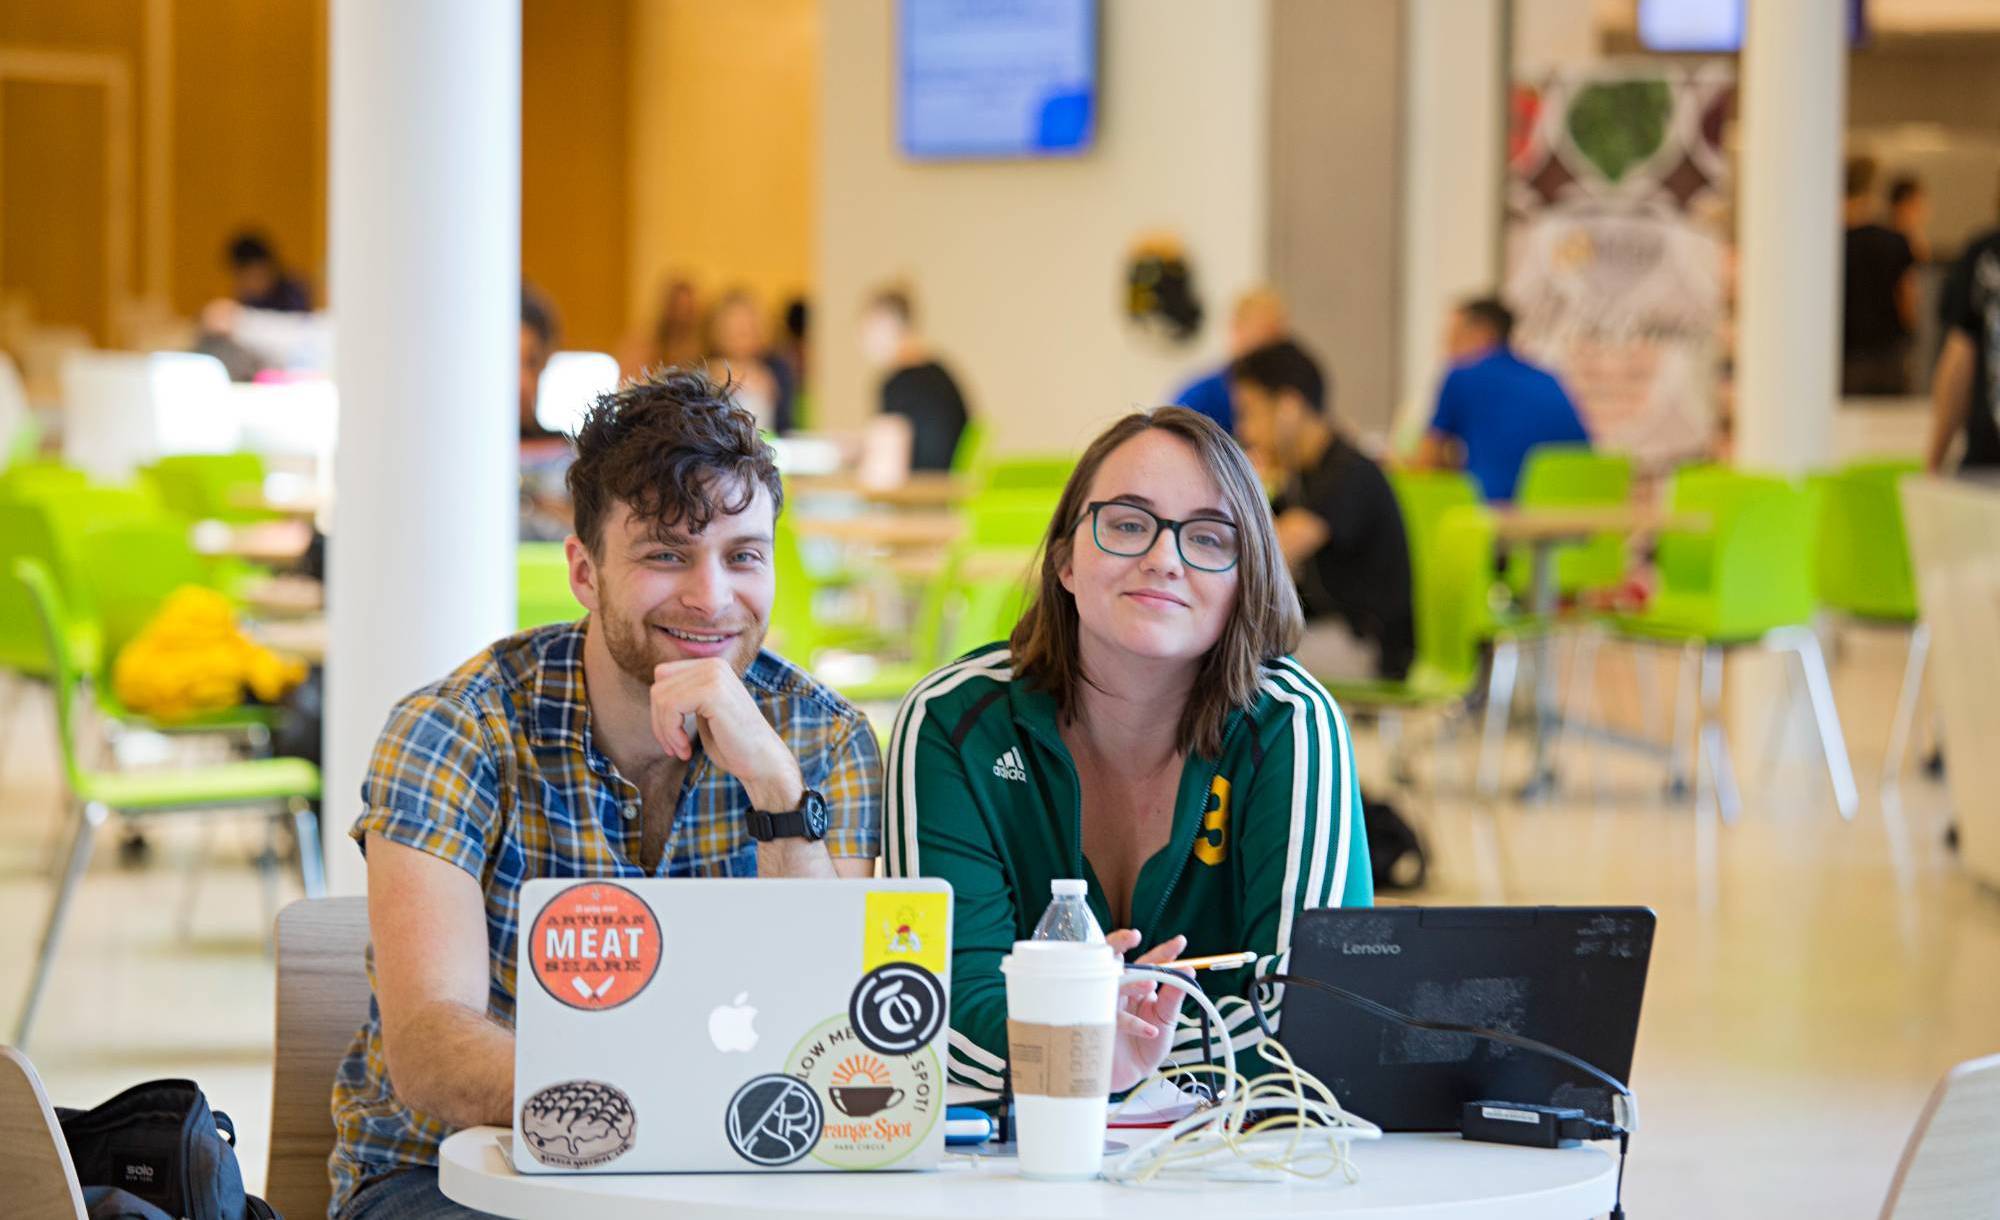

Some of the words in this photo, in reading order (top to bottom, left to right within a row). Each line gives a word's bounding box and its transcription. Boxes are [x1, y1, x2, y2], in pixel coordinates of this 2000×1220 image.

[546, 915, 644, 925] ARTISAN
[546, 928, 644, 959] MEAT
[1343, 942, 1400, 954] Lenovo
[545, 960, 641, 972] SHARE
[796, 1041, 825, 1078] LOW
[912, 1060, 930, 1112] SPOT!
[823, 1122, 872, 1143] range
[873, 1118, 912, 1143] Spot
[127, 1163, 154, 1176] solo
